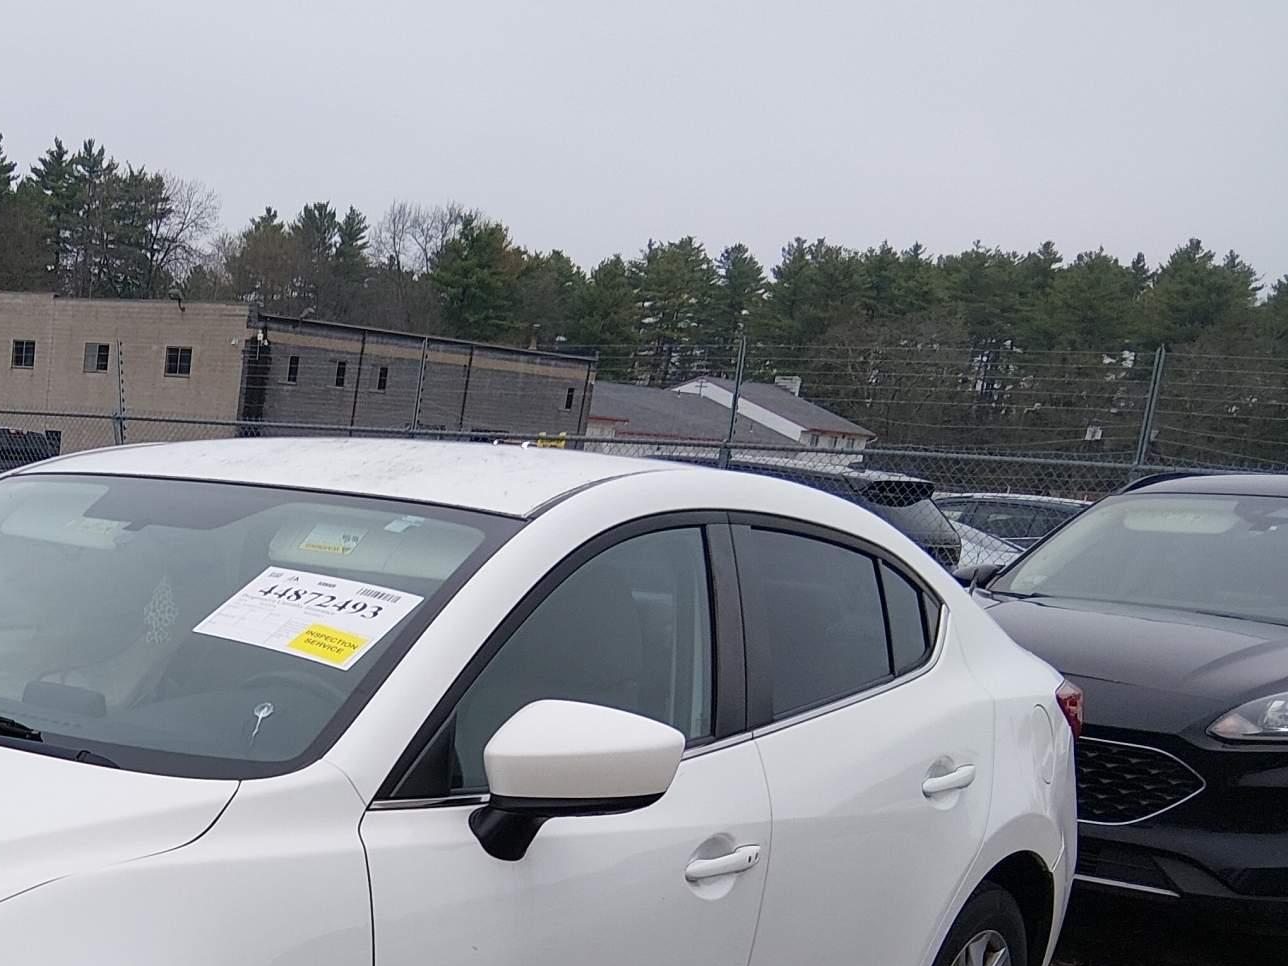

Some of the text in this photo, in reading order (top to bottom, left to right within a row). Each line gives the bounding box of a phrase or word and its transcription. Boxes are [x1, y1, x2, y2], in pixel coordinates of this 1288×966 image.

[259, 584, 383, 620] 44872493
[304, 638, 345, 655] SERVICE
[305, 629, 359, 651] INSPECTION
